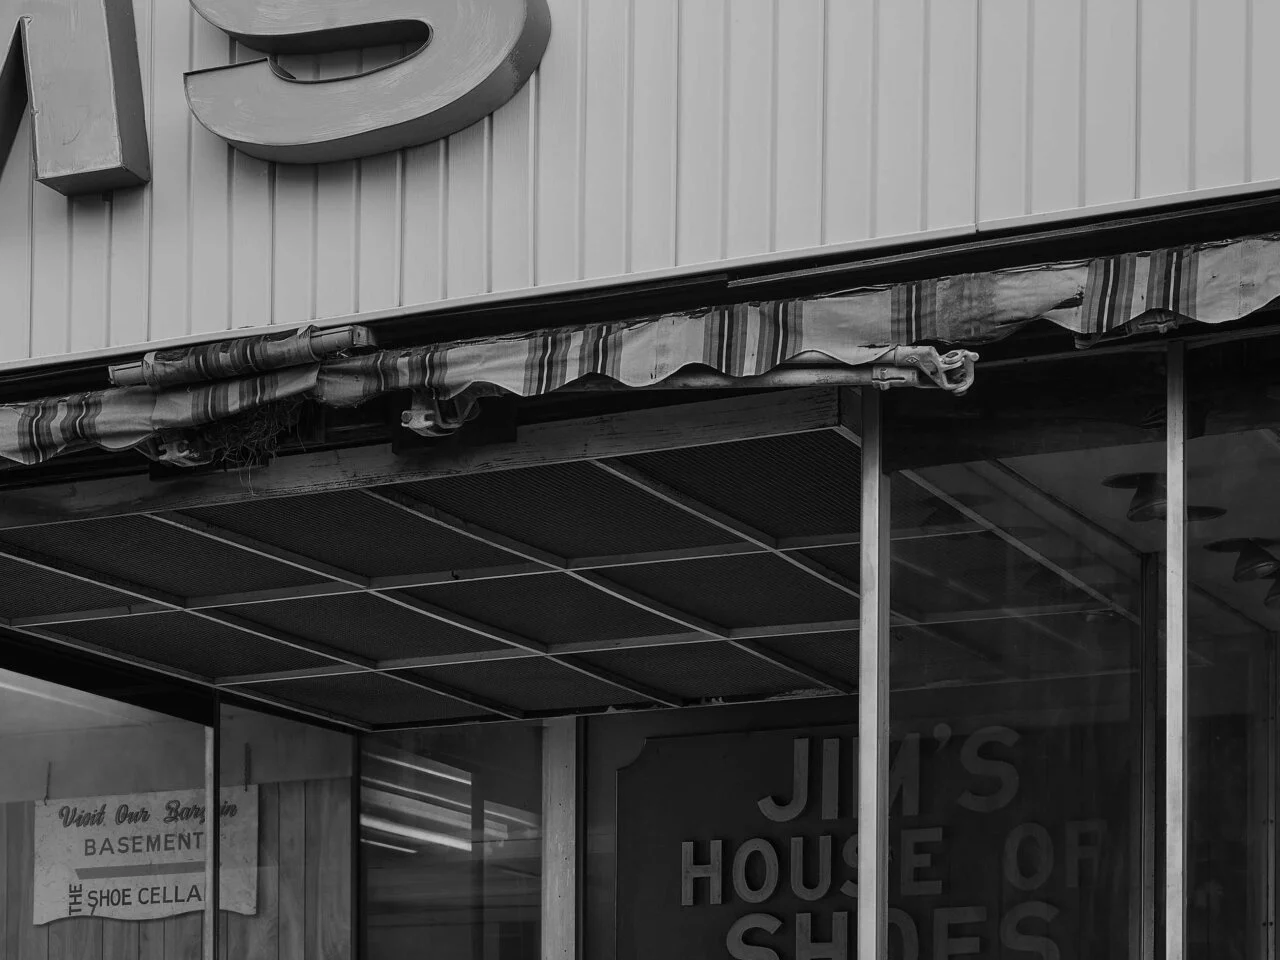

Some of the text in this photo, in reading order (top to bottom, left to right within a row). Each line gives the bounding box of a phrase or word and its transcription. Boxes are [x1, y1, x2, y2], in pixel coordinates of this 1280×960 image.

[757, 723, 1020, 822] JIM'S
[58, 799, 238, 828] Visit Our Bargin
[84, 832, 205, 857] BASEMENT
[68, 884, 83, 916] THE
[87, 884, 203, 914] SHOE CELLA
